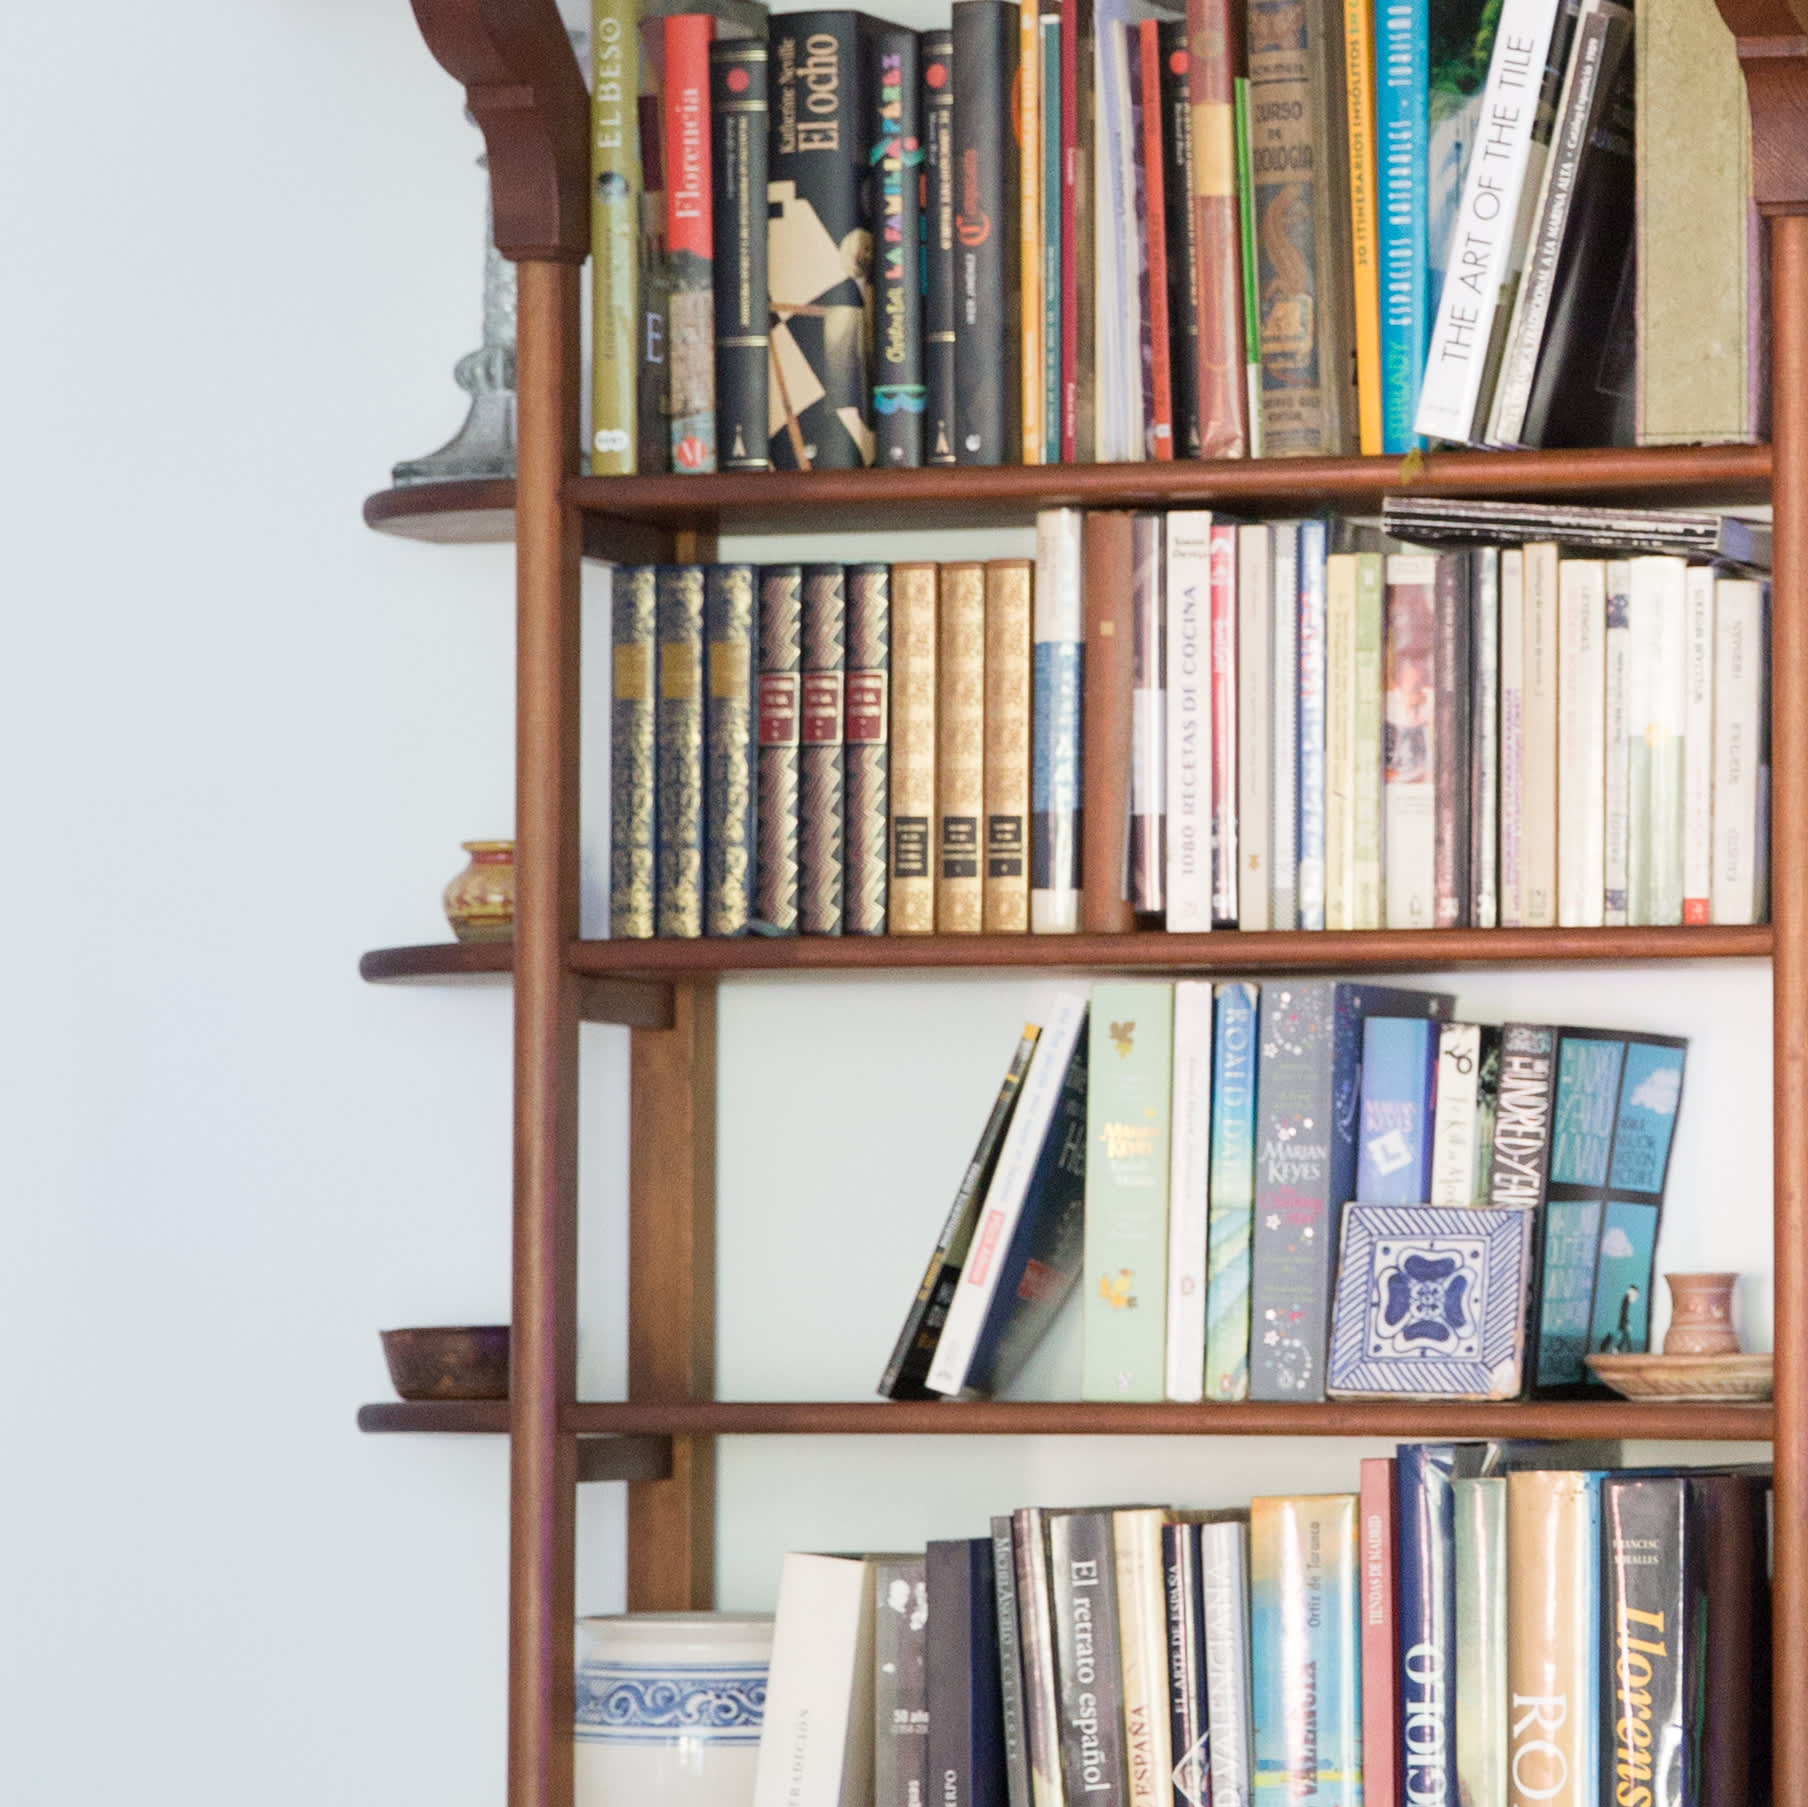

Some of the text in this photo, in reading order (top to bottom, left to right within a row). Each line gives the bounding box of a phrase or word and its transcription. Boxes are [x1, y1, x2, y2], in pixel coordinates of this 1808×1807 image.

[594, 16, 622, 149] EL BESO
[796, 34, 839, 152] El ocho
[674, 88, 701, 218] Florencia
[1441, 34, 1536, 363] THE ART OF THE TILE
[1182, 586, 1199, 678] COCINA
[1182, 688, 1198, 712] DE
[1182, 720, 1200, 817] RECETAS
[1257, 1138, 1329, 1163] MARIAN
[1267, 1161, 1323, 1184] KEYES
[1366, 1515, 1384, 1625] TIENDAS DE MADRID
[1071, 1559, 1112, 1792] El retrato español
[1168, 1564, 1185, 1713] EL ARTE DE ESPAÑA
[1206, 1558, 1238, 1776] VALENCIANA
[1130, 1704, 1150, 1796] ESPAÑA
[1294, 1660, 1318, 1796] VALENCIA
